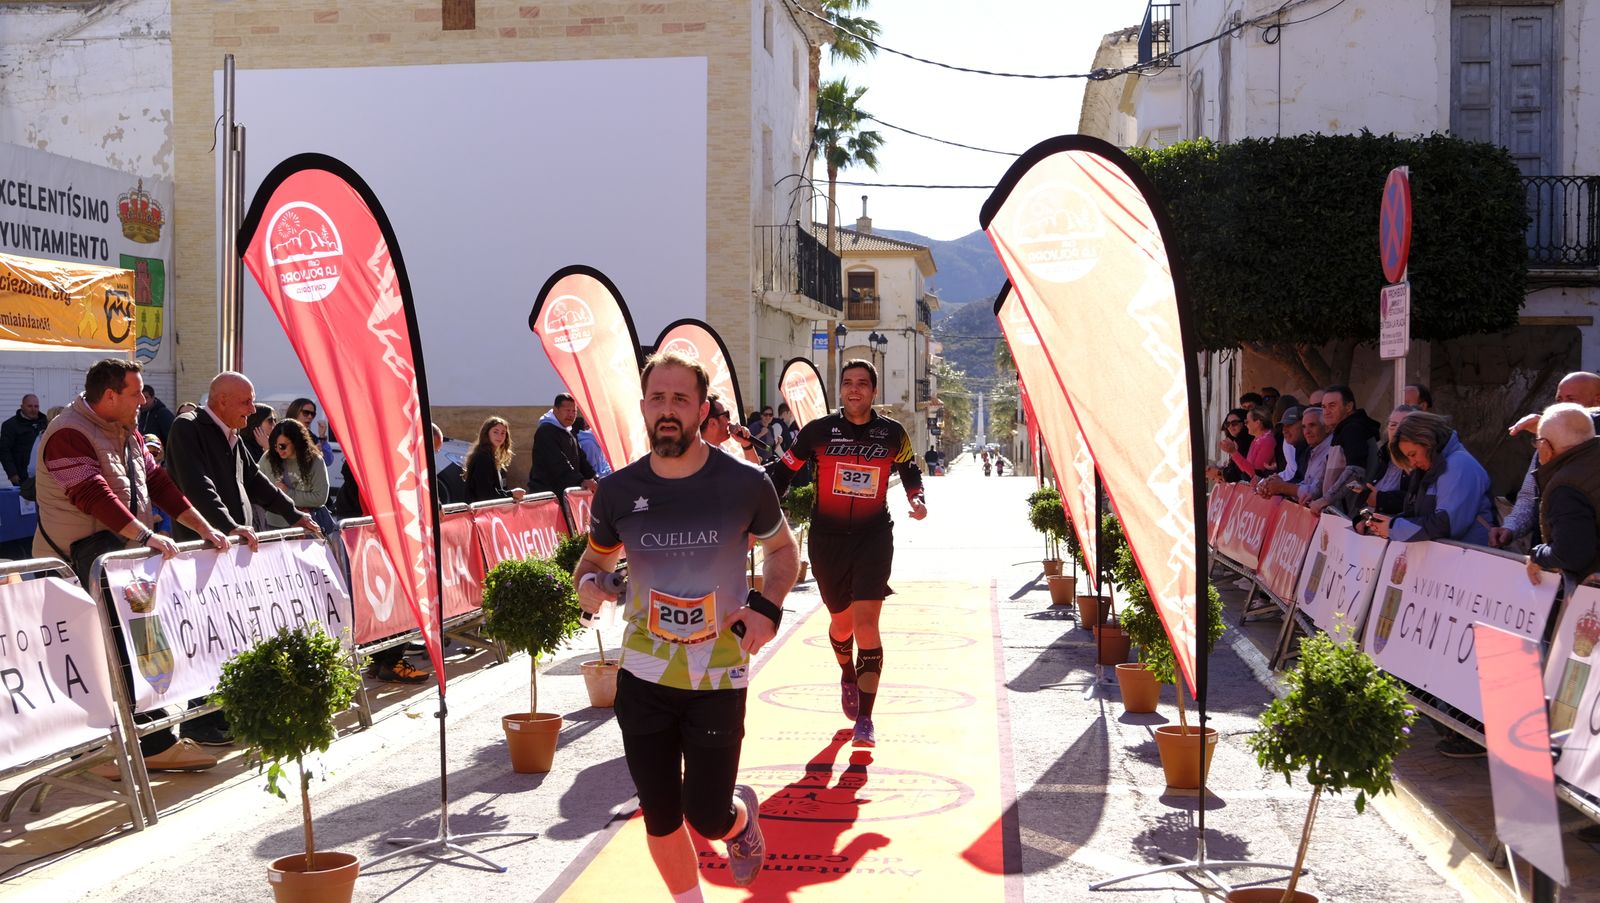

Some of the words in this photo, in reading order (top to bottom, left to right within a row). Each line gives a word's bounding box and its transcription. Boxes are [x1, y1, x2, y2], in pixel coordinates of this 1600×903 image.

[0, 221, 109, 261] YUNTAMIENTO
[842, 471, 871, 484] 327
[640, 530, 719, 548] CUELLAR
[172, 574, 305, 611] AYUNTAMIENTO
[310, 567, 331, 586] DE
[1412, 576, 1513, 626] AYUNTAMIENTO
[1514, 607, 1536, 635] DE
[39, 619, 71, 648] DE
[178, 591, 341, 660] CANTORIA
[659, 605, 704, 626] 202
[1400, 602, 1476, 665] CANTO
[1, 652, 90, 715] RIA
